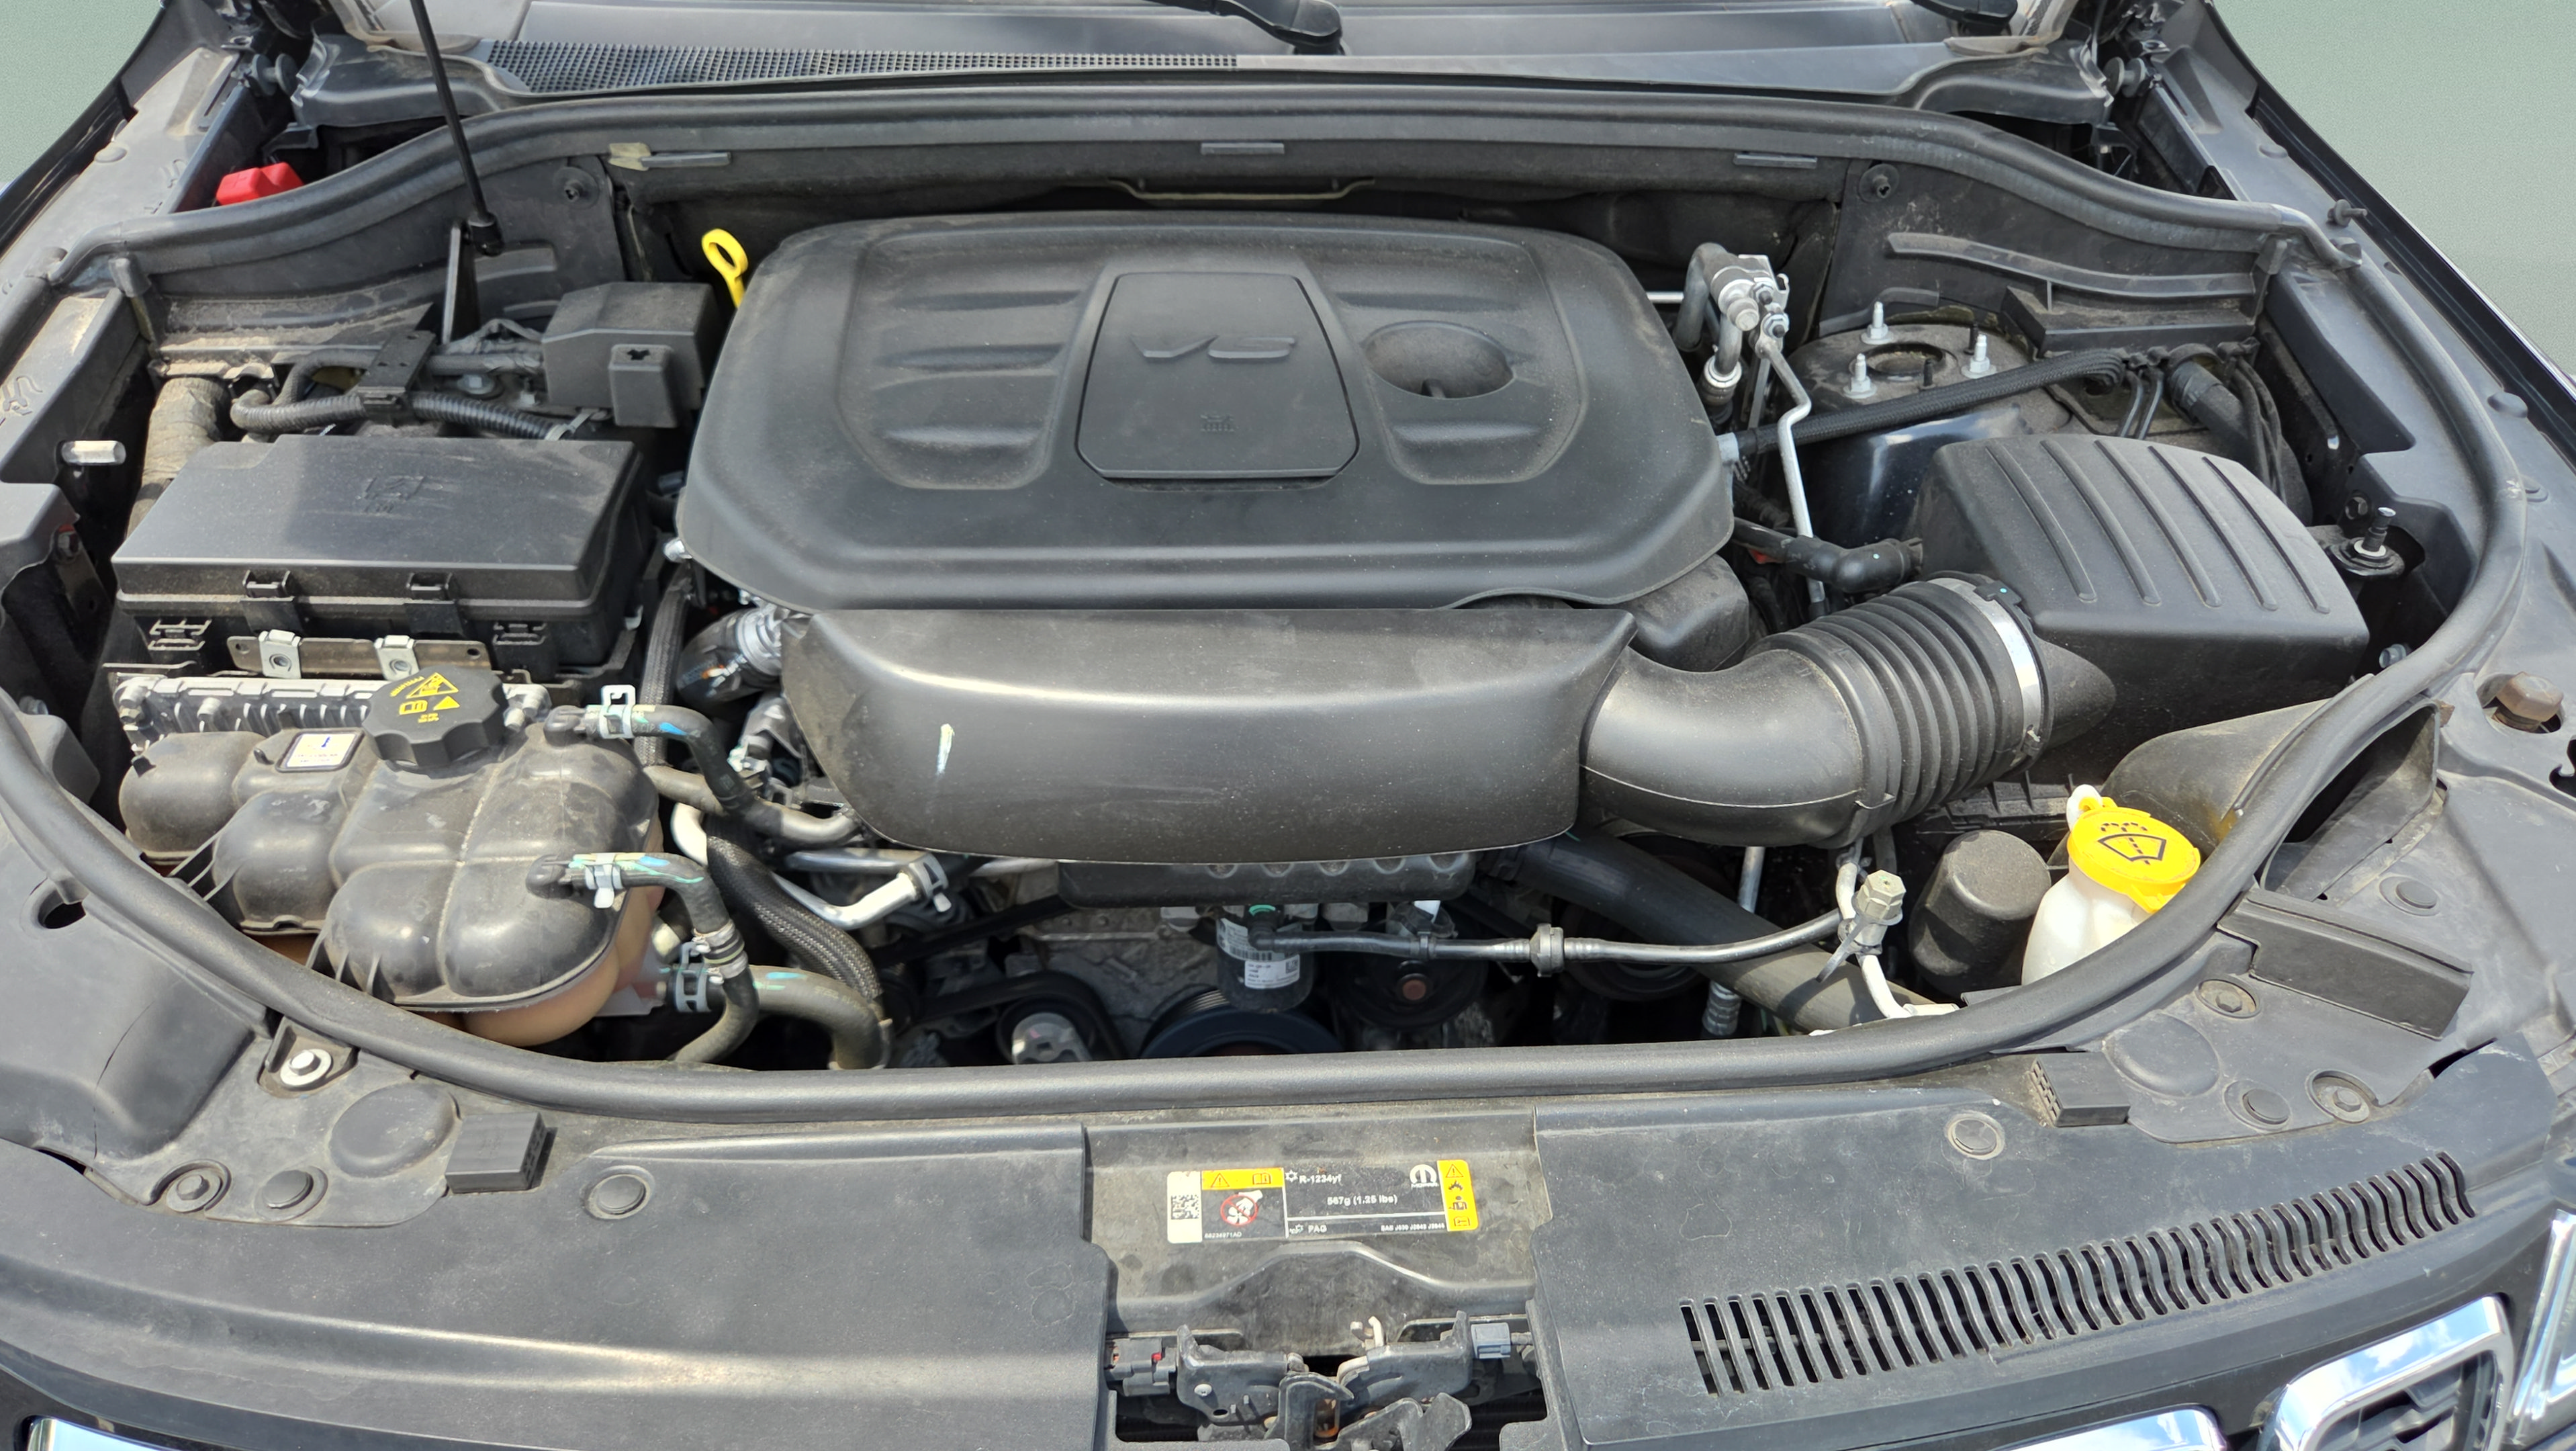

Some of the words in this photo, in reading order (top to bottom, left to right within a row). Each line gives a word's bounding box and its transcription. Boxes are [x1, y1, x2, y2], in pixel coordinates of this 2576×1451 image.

[1299, 1174, 1342, 1184] R-1234yf
[1327, 1196, 1351, 1206] 567g
[1352, 1195, 1377, 1206] (1.25
